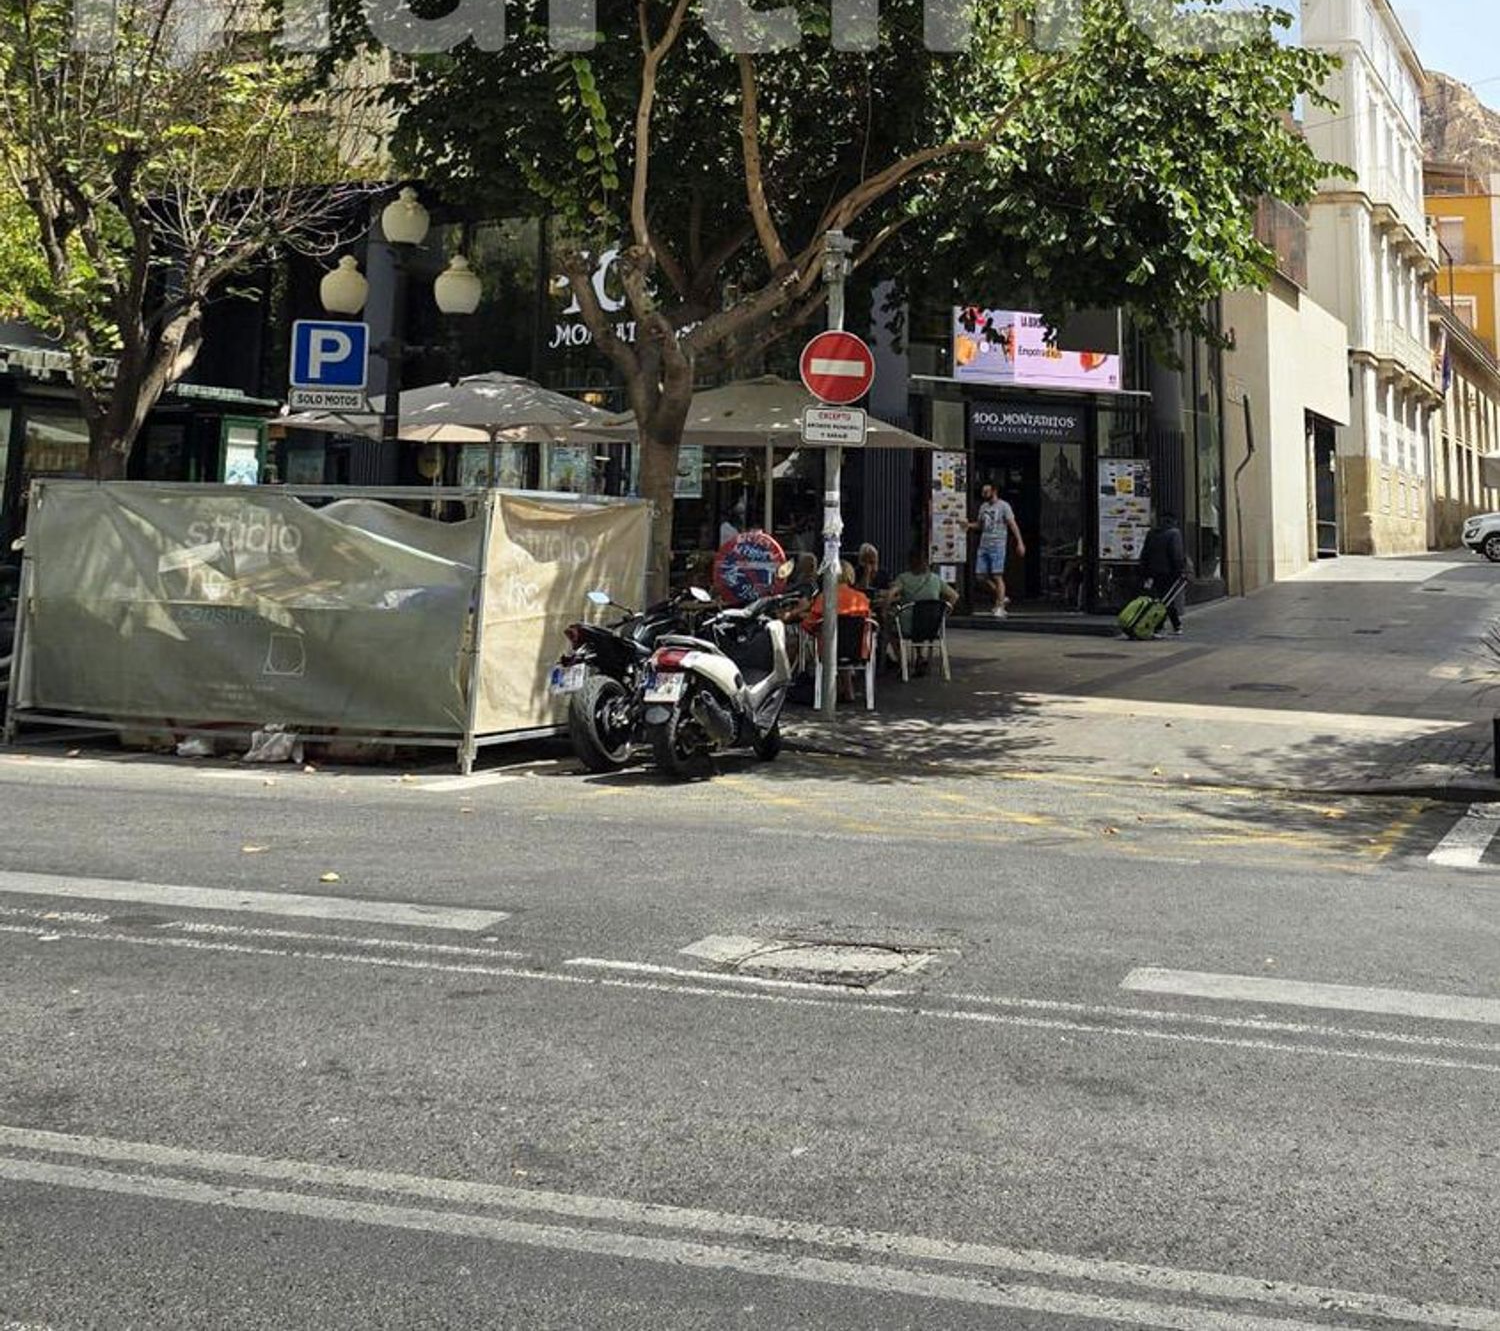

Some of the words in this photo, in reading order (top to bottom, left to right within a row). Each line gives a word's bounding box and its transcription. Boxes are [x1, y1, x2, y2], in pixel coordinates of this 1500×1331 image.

[308, 329, 352, 378] P
[297, 394, 322, 404] SOLO
[325, 395, 358, 406] MOTOS
[972, 412, 999, 425] 100
[999, 413, 1074, 429] MONTADITOS
[184, 512, 302, 554] studio
